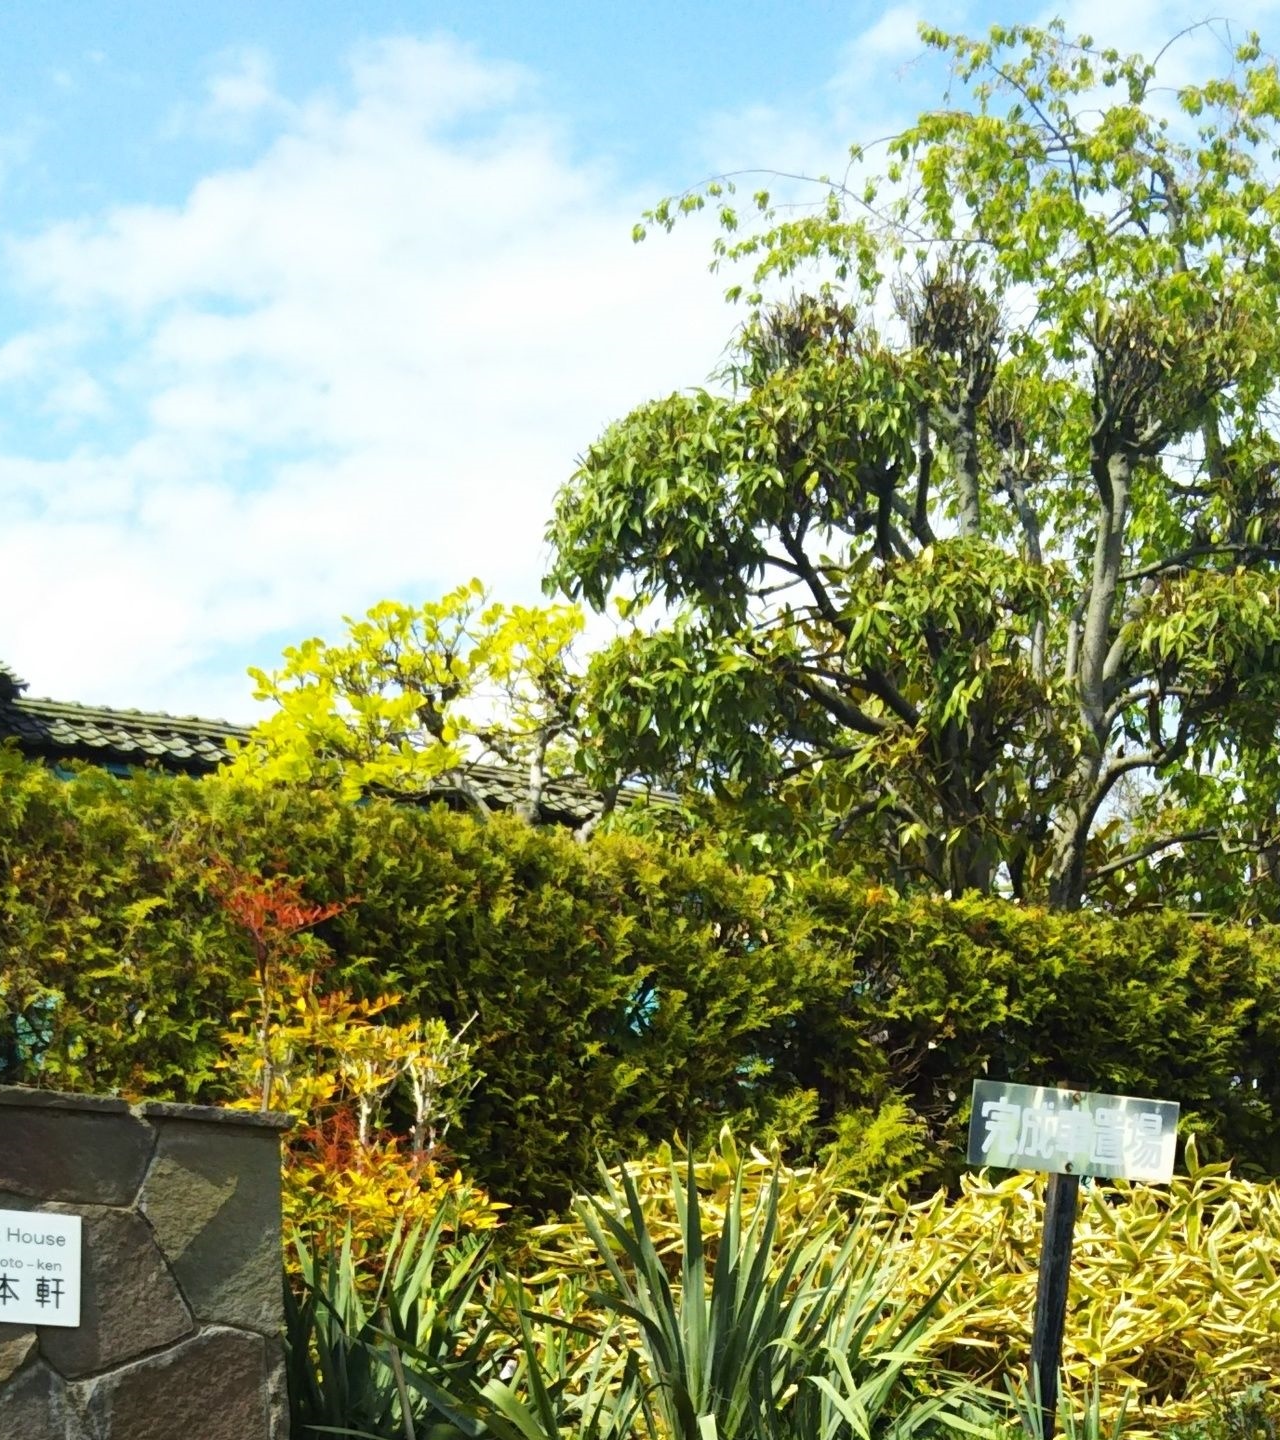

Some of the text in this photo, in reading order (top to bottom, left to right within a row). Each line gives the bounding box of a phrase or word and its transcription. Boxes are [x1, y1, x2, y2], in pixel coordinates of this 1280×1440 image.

[980, 1096, 1164, 1169] 完成車置場
[7, 1227, 66, 1247] House
